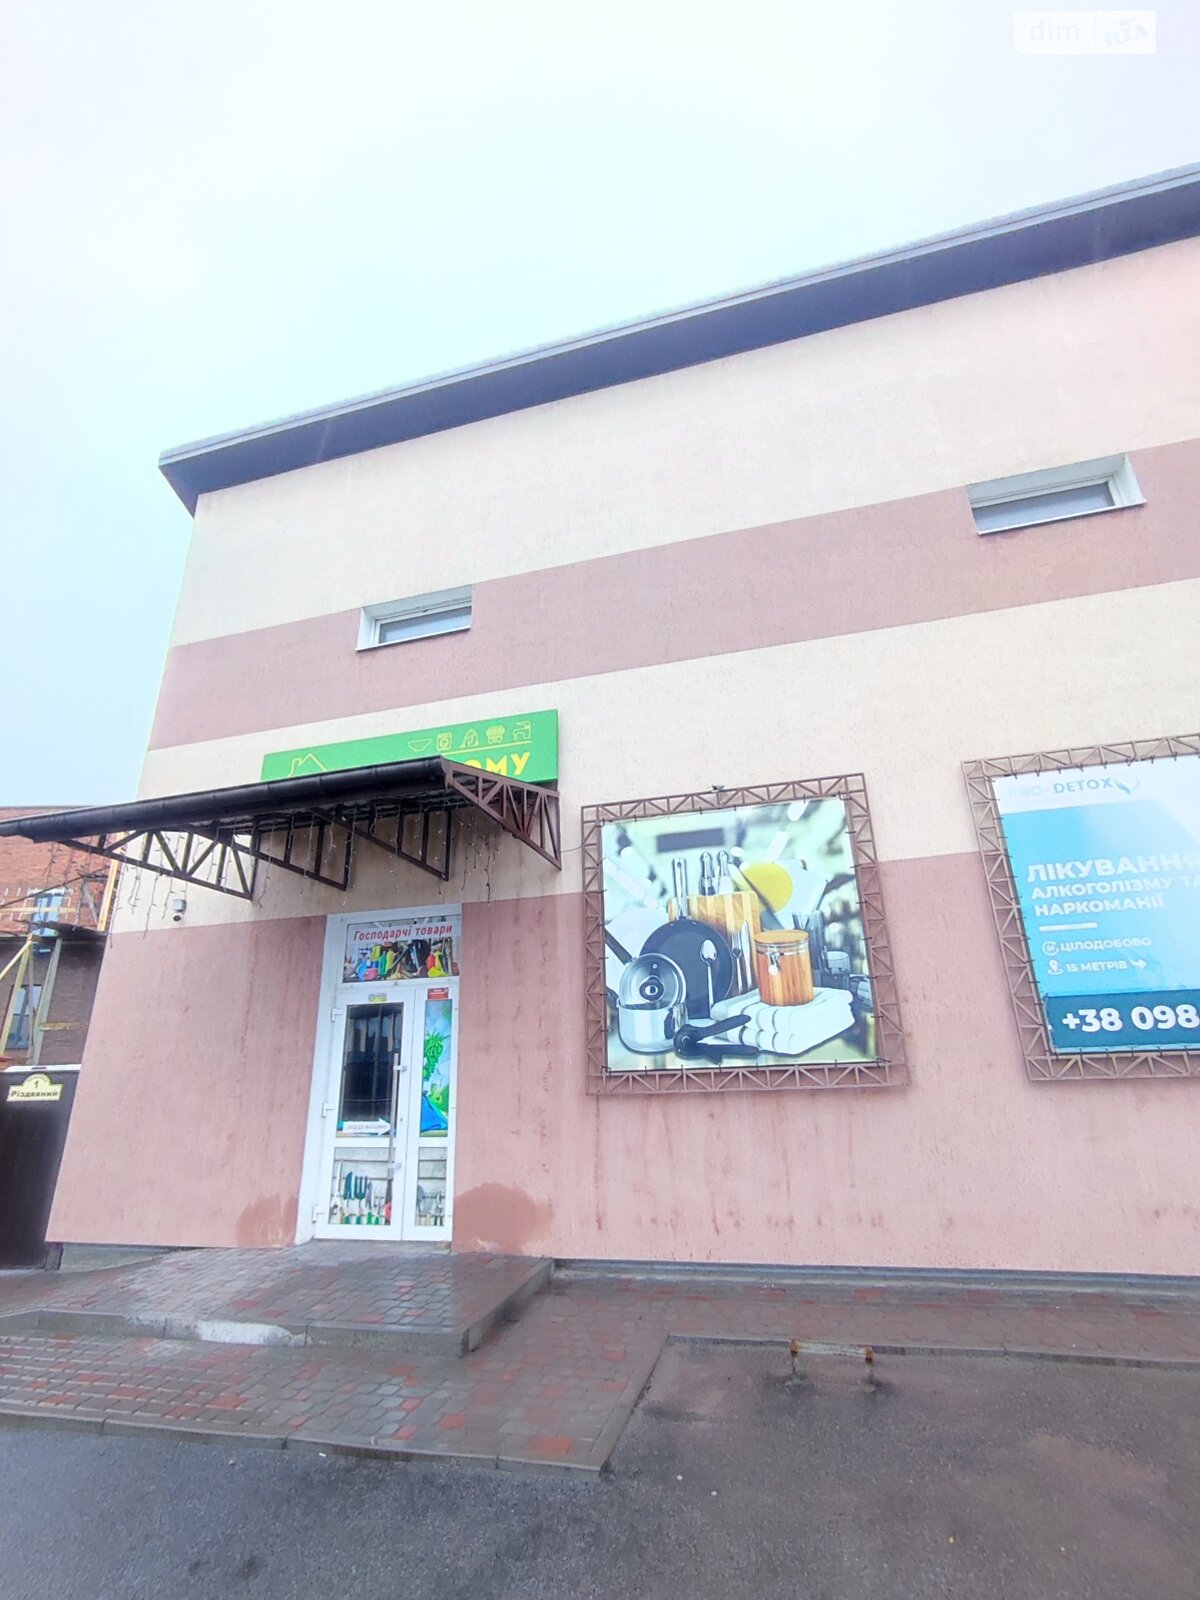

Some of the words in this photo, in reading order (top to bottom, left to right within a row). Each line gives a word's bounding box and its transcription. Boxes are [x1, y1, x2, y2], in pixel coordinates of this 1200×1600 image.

[1031, 876, 1173, 900] АЛКОГОЛІЗМУ
[1035, 893, 1166, 917] НАРКОМАНІЇ
[354, 927, 411, 941] Господарчі
[415, 925, 453, 936] товари
[1060, 937, 1153, 952] ЦІЛОДОБОВО
[1066, 962, 1078, 973] 15
[1081, 960, 1127, 971] МЕТРІВ
[1062, 1007, 1123, 1033] +38
